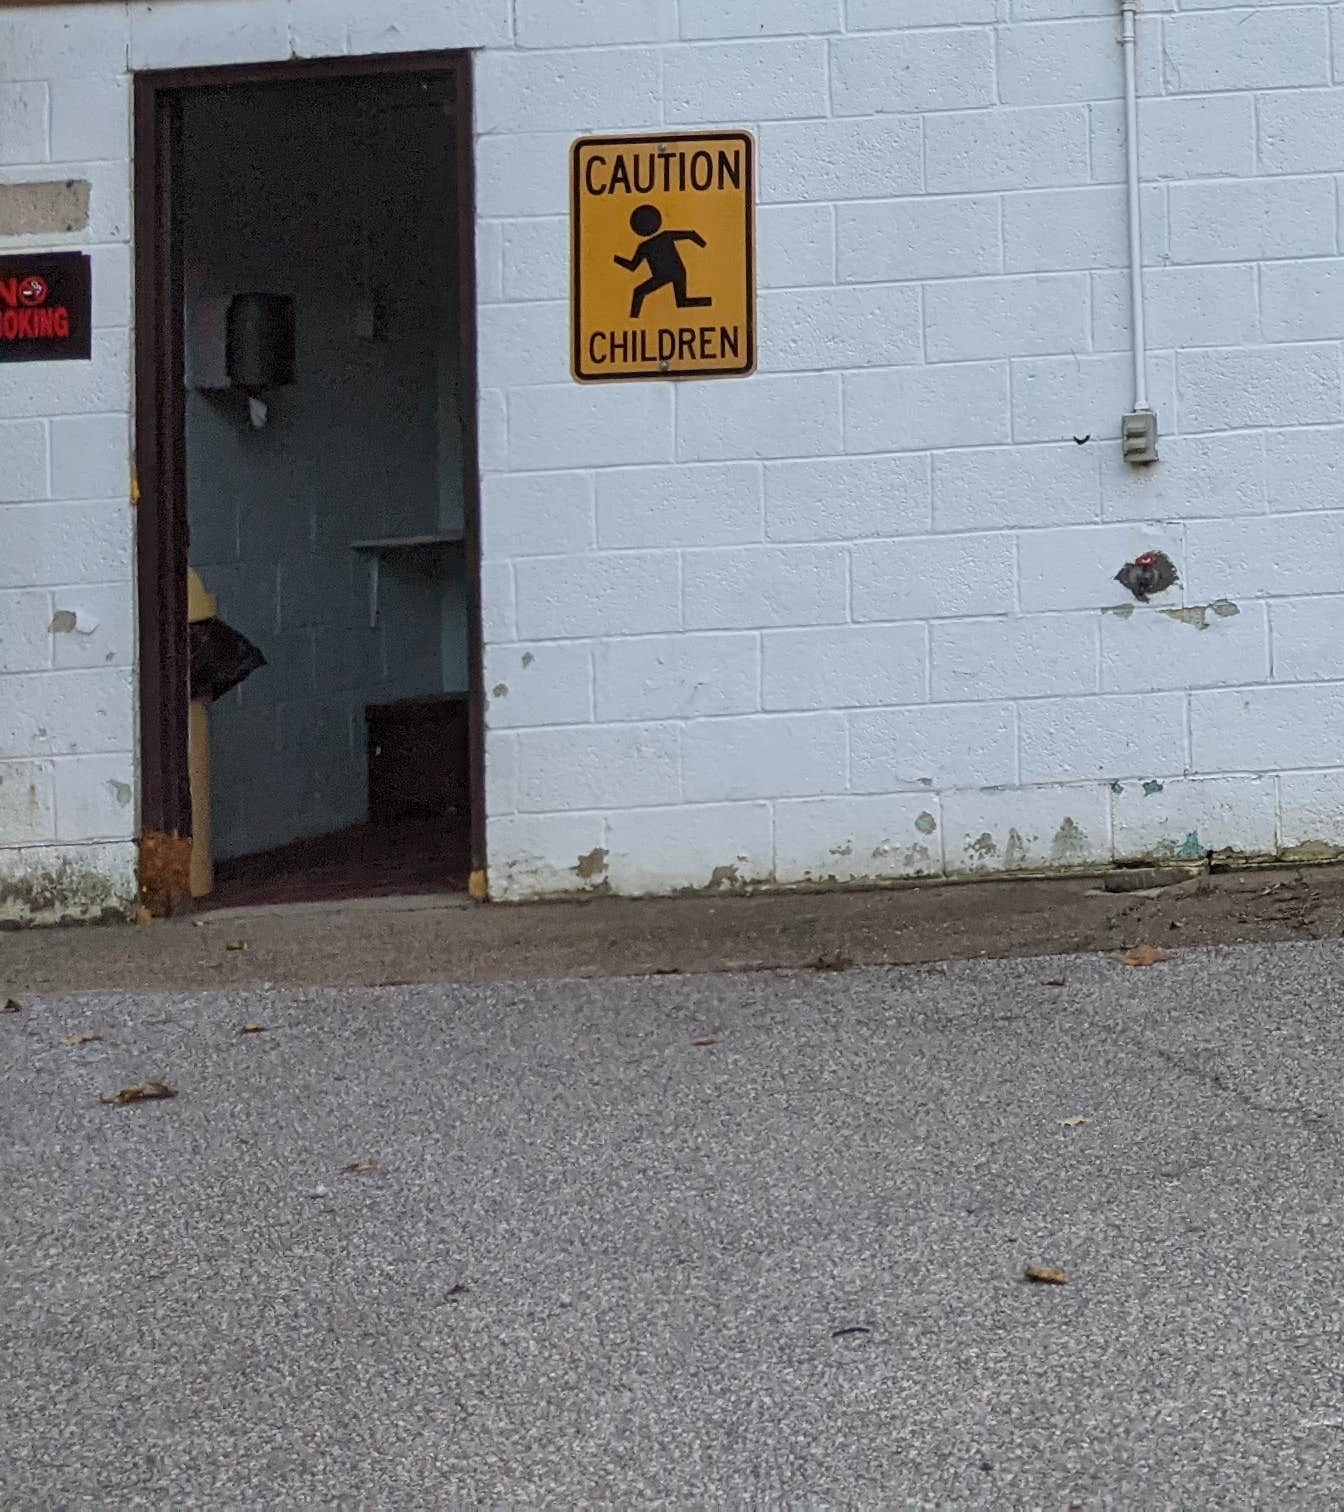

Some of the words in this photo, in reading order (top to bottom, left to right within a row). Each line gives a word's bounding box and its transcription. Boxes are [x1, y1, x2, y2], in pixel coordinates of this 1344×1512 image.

[585, 150, 741, 196] CAUTION
[0, 306, 70, 340] OKING
[589, 326, 740, 364] CHILDREN
